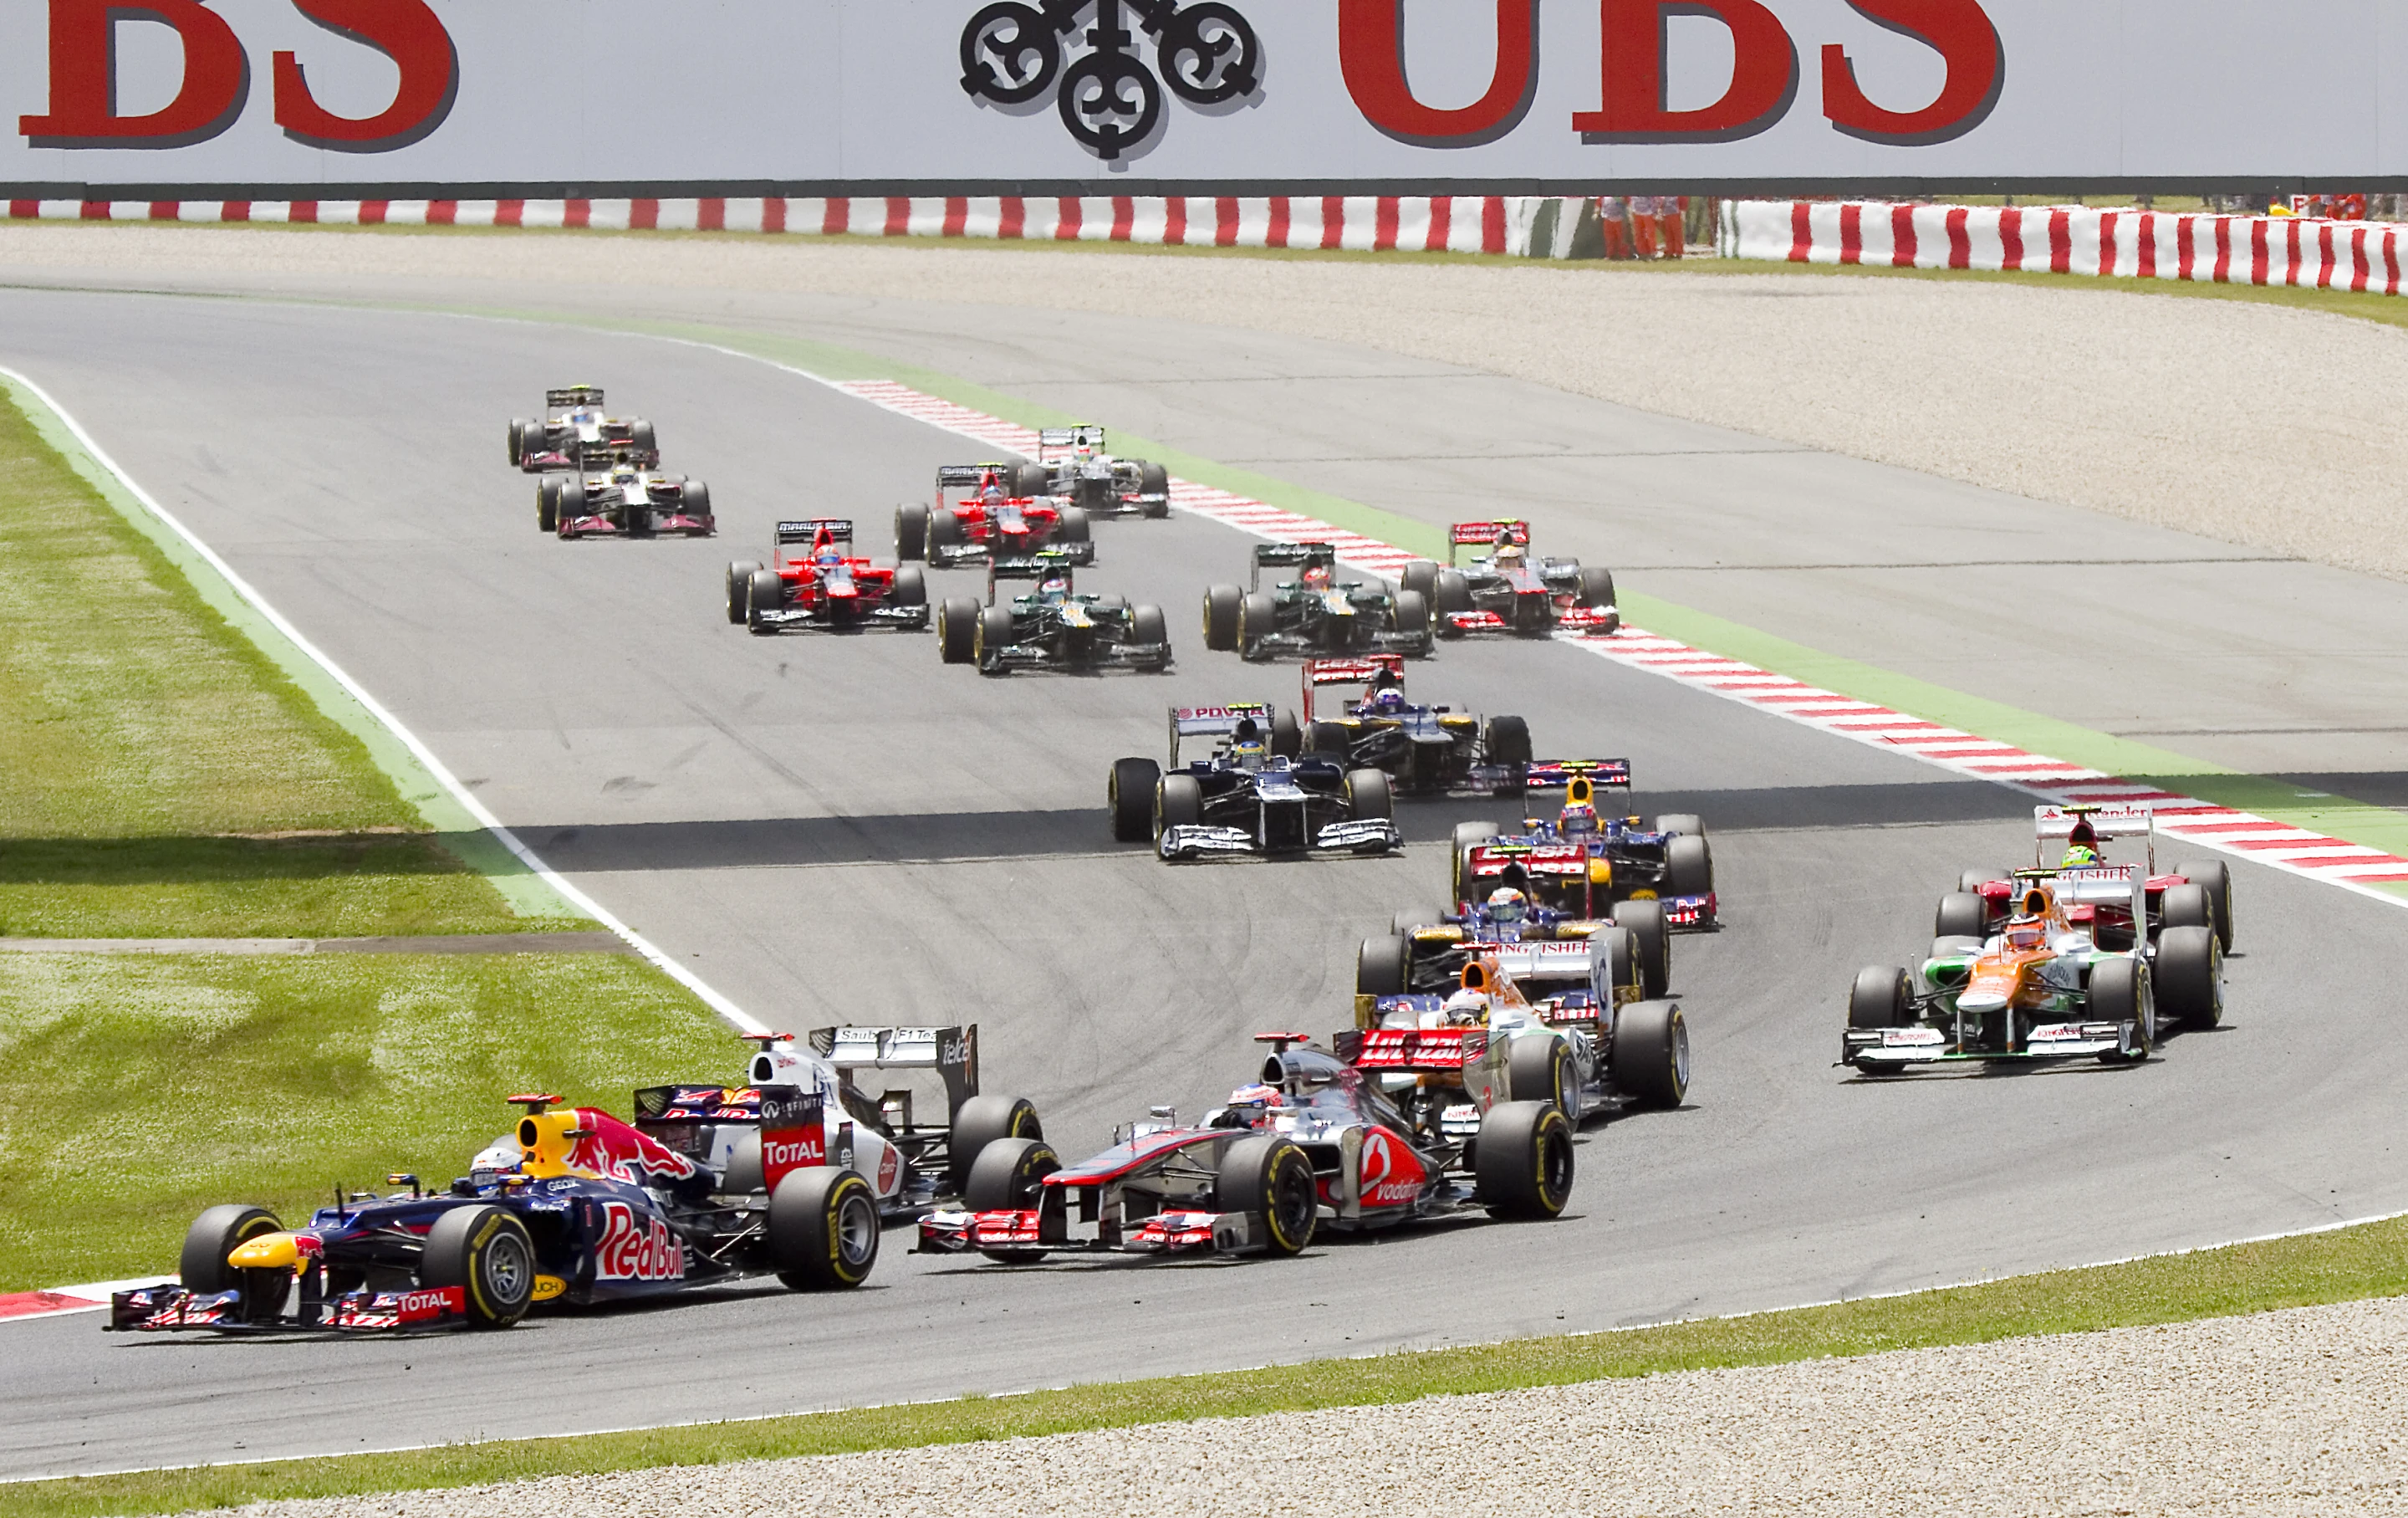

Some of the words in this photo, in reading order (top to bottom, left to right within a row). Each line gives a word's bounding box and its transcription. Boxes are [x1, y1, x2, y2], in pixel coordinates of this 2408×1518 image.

[917, 1030, 937, 1040] Tea
[763, 1140, 824, 1166] TOTAL
[398, 1292, 452, 1312] TOTAL
